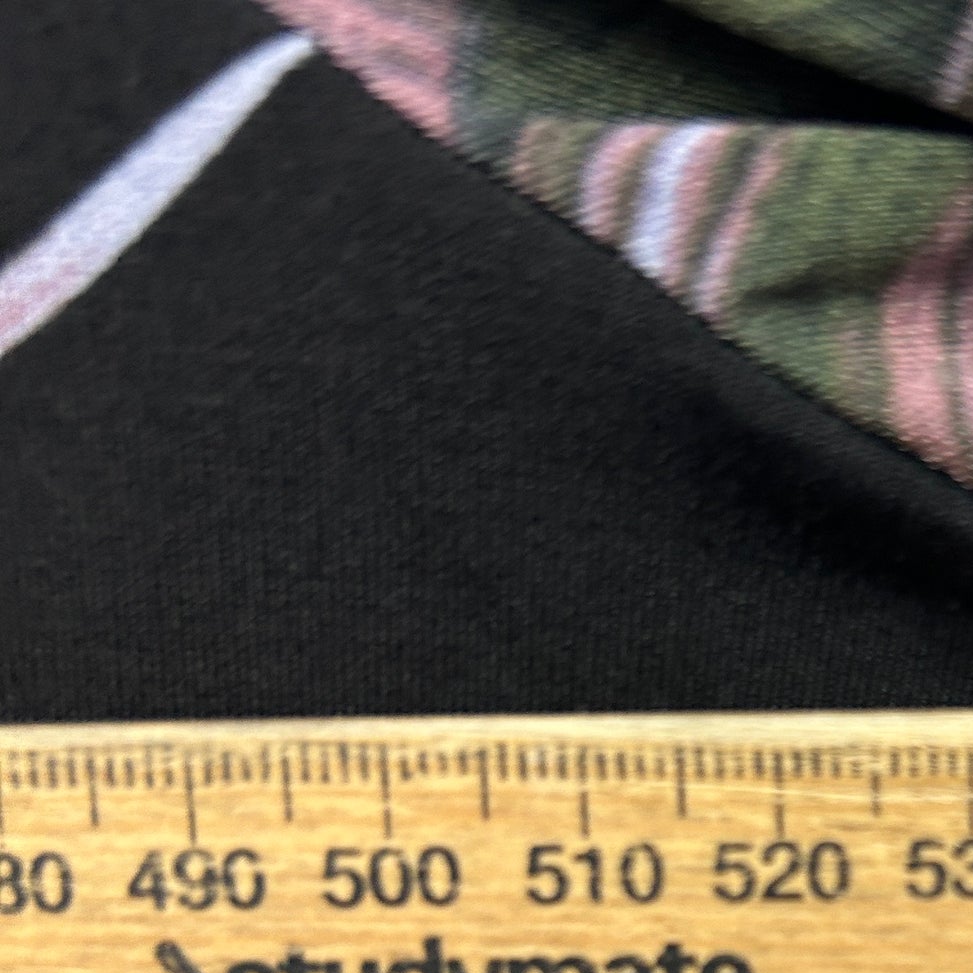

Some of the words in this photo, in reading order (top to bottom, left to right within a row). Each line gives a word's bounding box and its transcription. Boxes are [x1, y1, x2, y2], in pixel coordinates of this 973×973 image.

[127, 848, 267, 912] 490
[321, 844, 460, 909] 500
[525, 842, 665, 906] 510
[712, 840, 851, 903] 520
